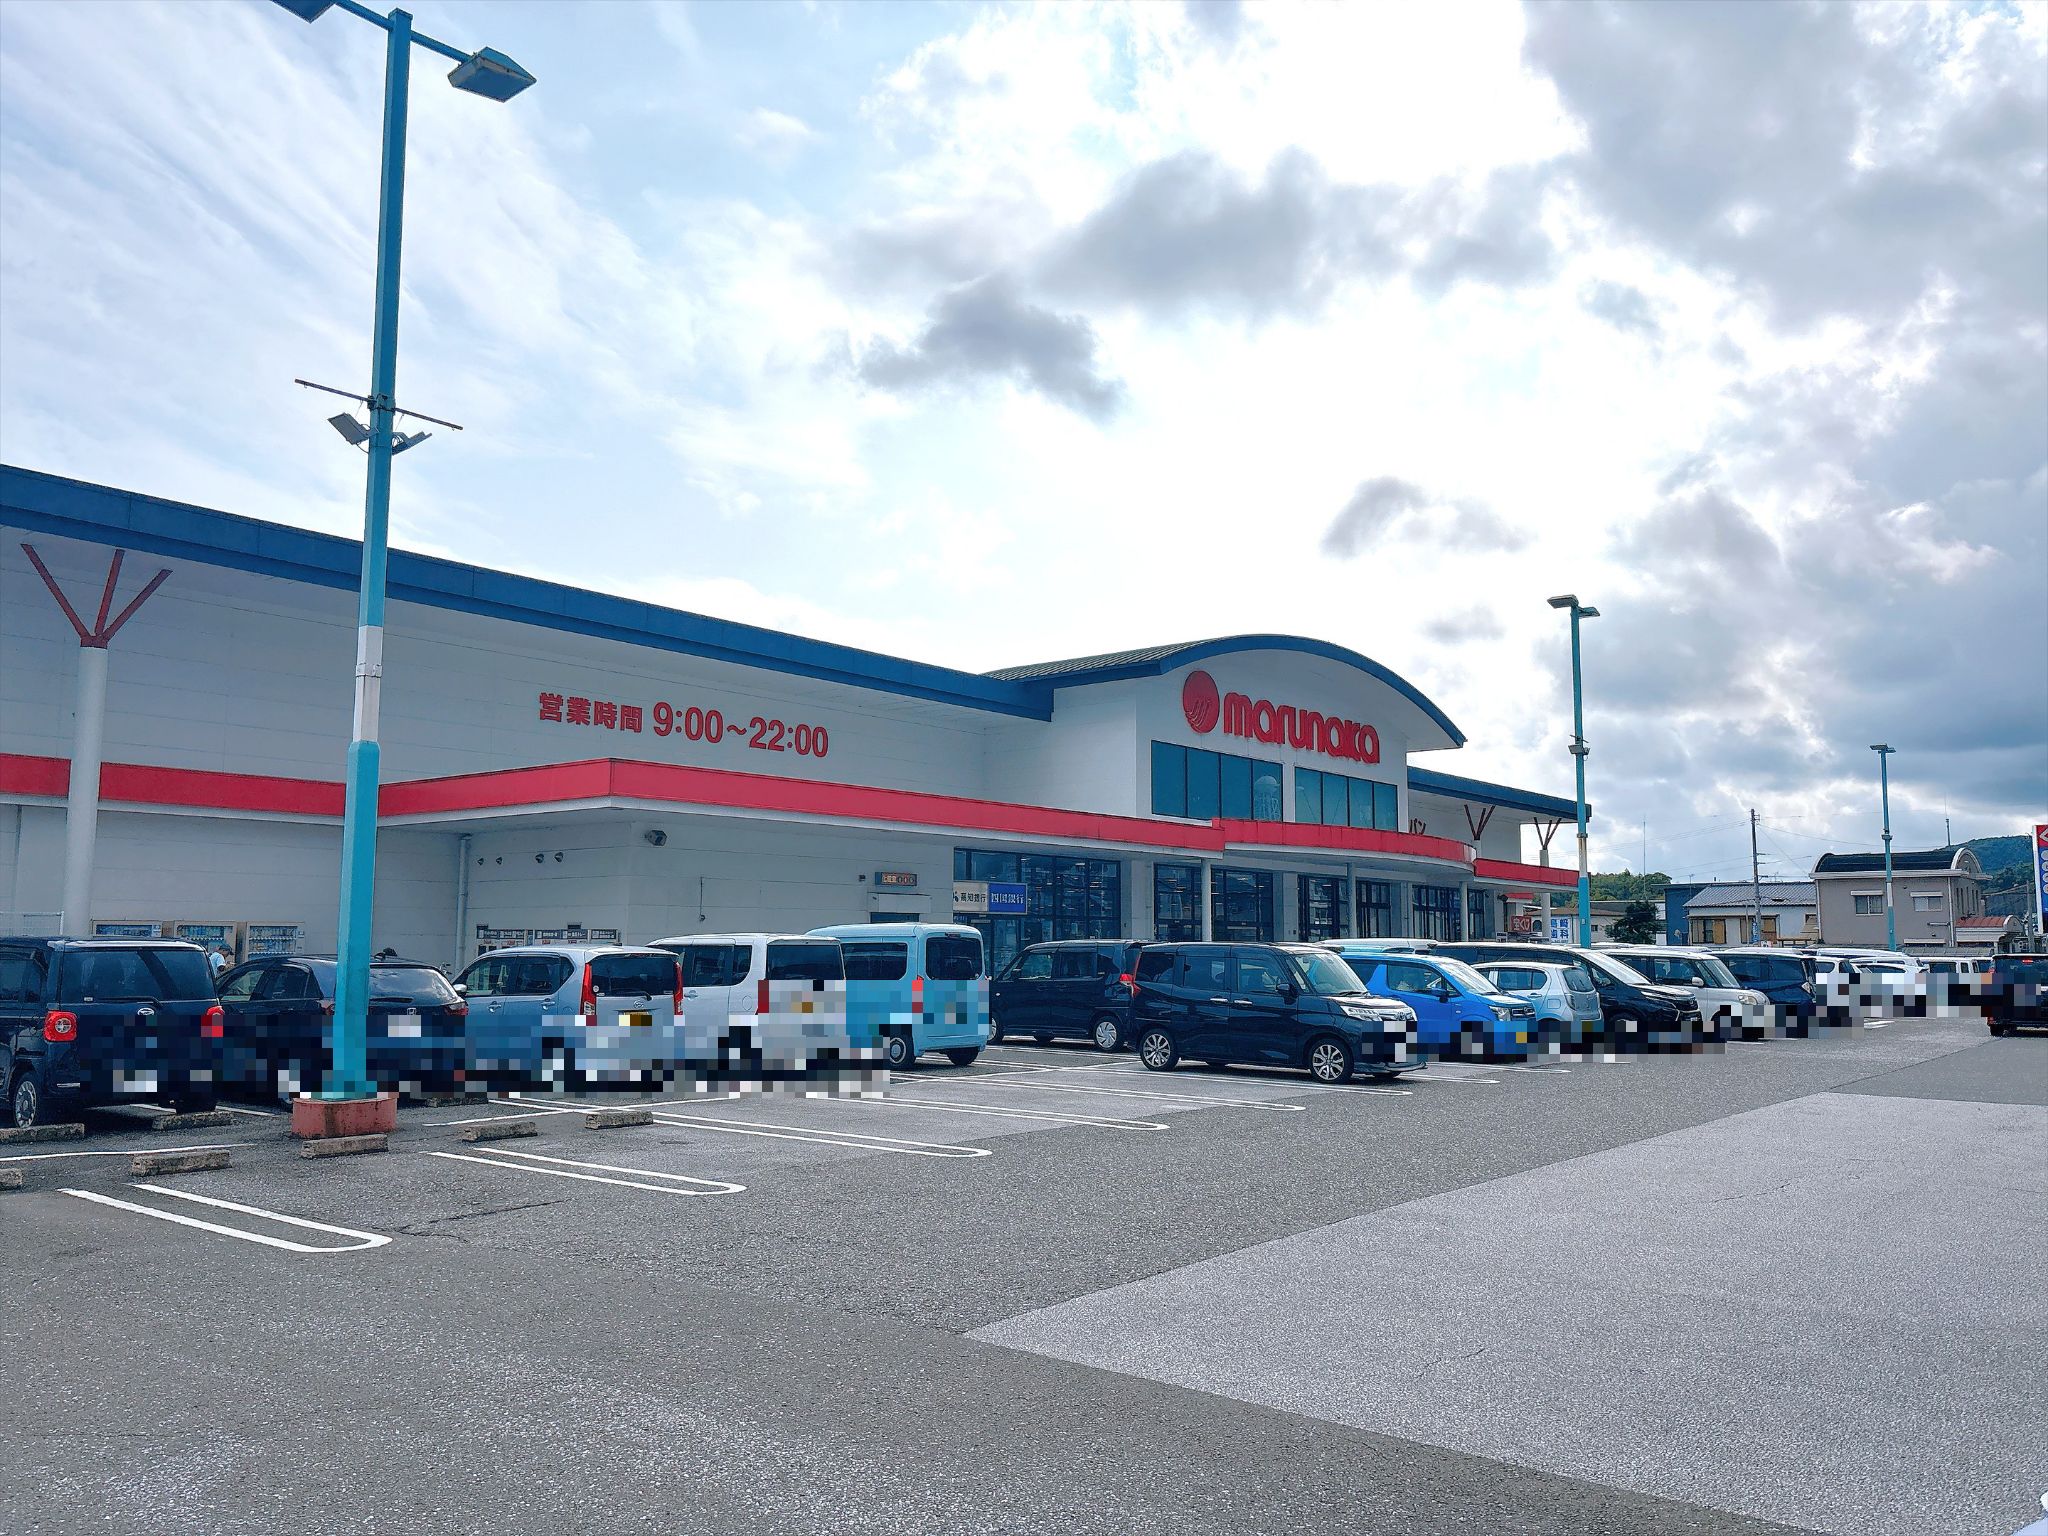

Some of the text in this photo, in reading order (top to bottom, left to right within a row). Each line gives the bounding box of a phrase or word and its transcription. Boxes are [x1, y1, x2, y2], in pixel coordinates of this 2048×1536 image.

[539, 692, 643, 733] 営業時間
[1223, 692, 1380, 764] marunaka
